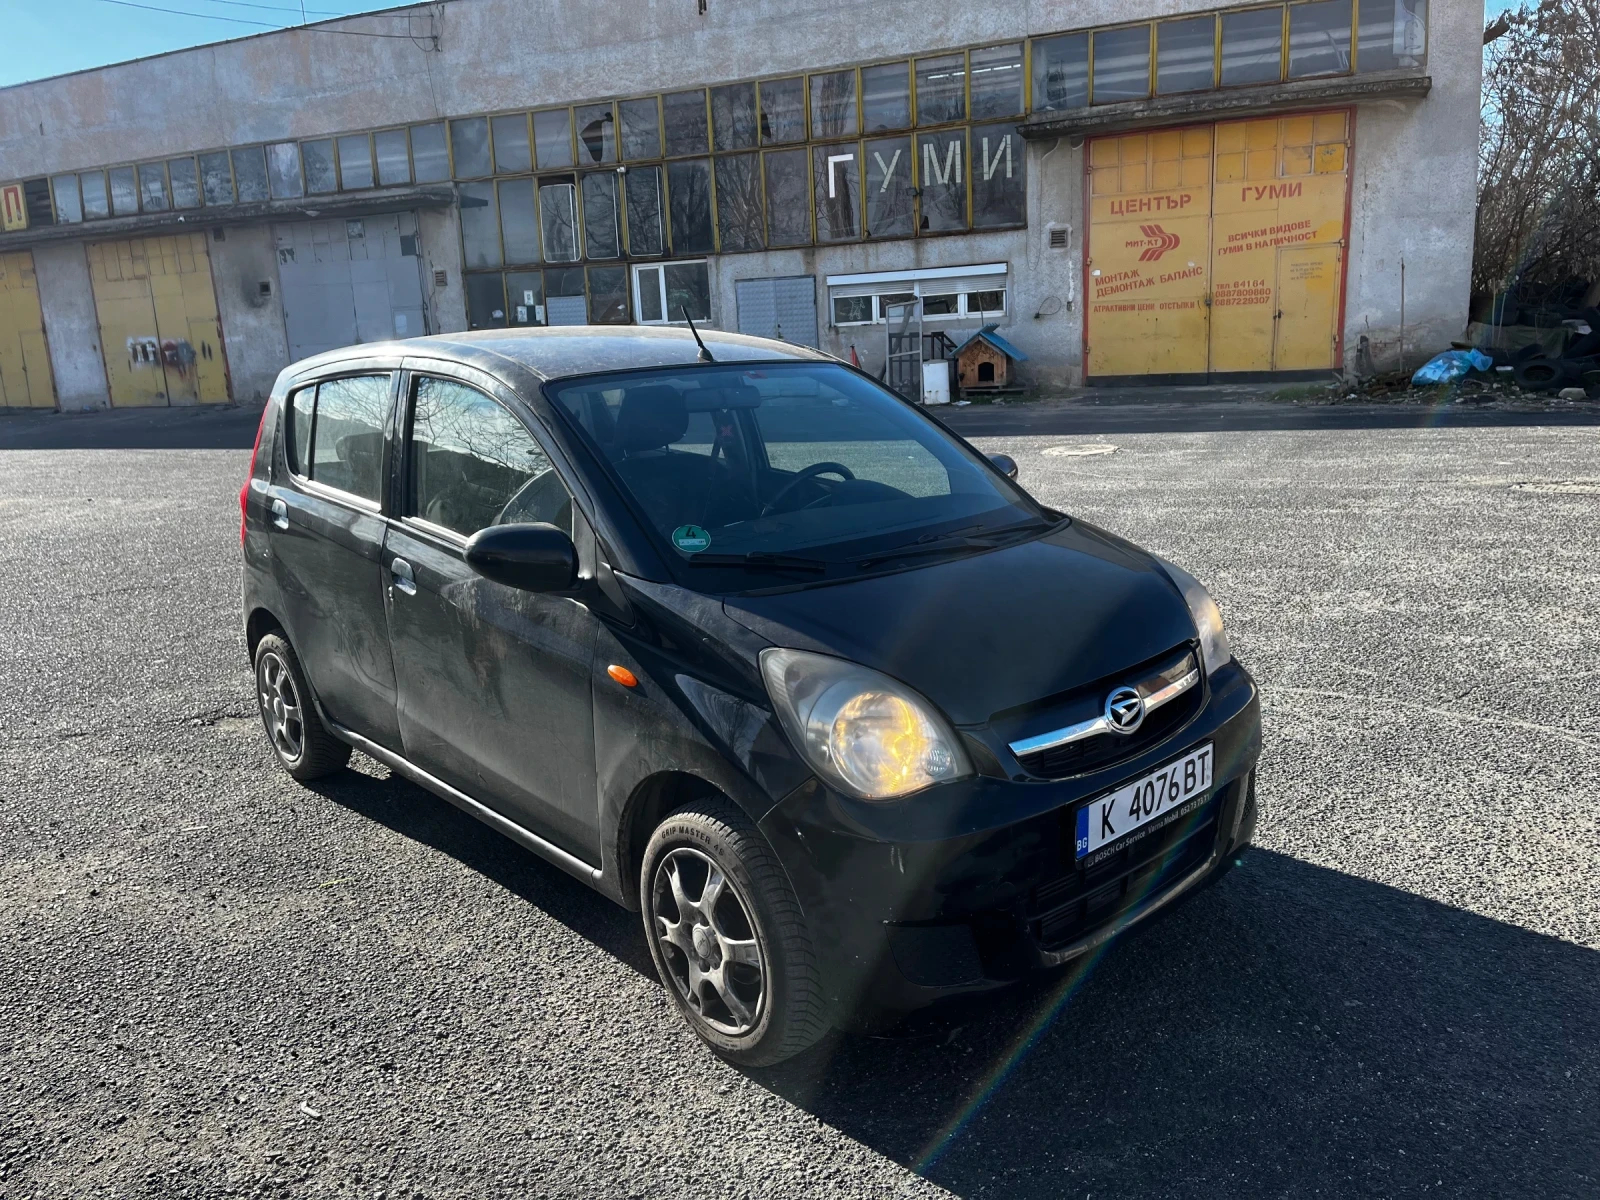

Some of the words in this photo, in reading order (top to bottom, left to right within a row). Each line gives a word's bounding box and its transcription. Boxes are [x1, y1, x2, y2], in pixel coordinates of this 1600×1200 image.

[828, 134, 1012, 198] ГУМИ
[1110, 193, 1192, 216] ЦЕНТЪР
[1241, 182, 1302, 202] ГУМИ
[1228, 228, 1267, 242] ВСИЧКИ
[1269, 219, 1311, 235] ВИДОВЕ
[1218, 244, 1244, 256] ГУМИ
[1246, 242, 1252, 251] В
[1254, 230, 1318, 249] НАЛИЧНОСТ
[1095, 269, 1140, 287] МОНТАЖ
[1096, 277, 1155, 299] ДЕМОНТАЖ
[1159, 266, 1203, 283] БАЛАНС
[1093, 303, 1136, 313] АТРАКТИВНИ
[1137, 303, 1155, 312] ЦЕНИ
[1159, 301, 1195, 310] ОТСТЪПКИ
[685, 526, 697, 539] 4
[1101, 799, 1116, 840] K
[1129, 767, 1180, 822] 4076
[1184, 750, 1210, 796] BT
[661, 826, 677, 839] GRIP
[678, 826, 711, 845] MASTER
[1076, 837, 1088, 852] BG
[1094, 844, 1115, 864] BOSCH
[1115, 841, 1126, 852] Car
[1126, 831, 1146, 847] Service
